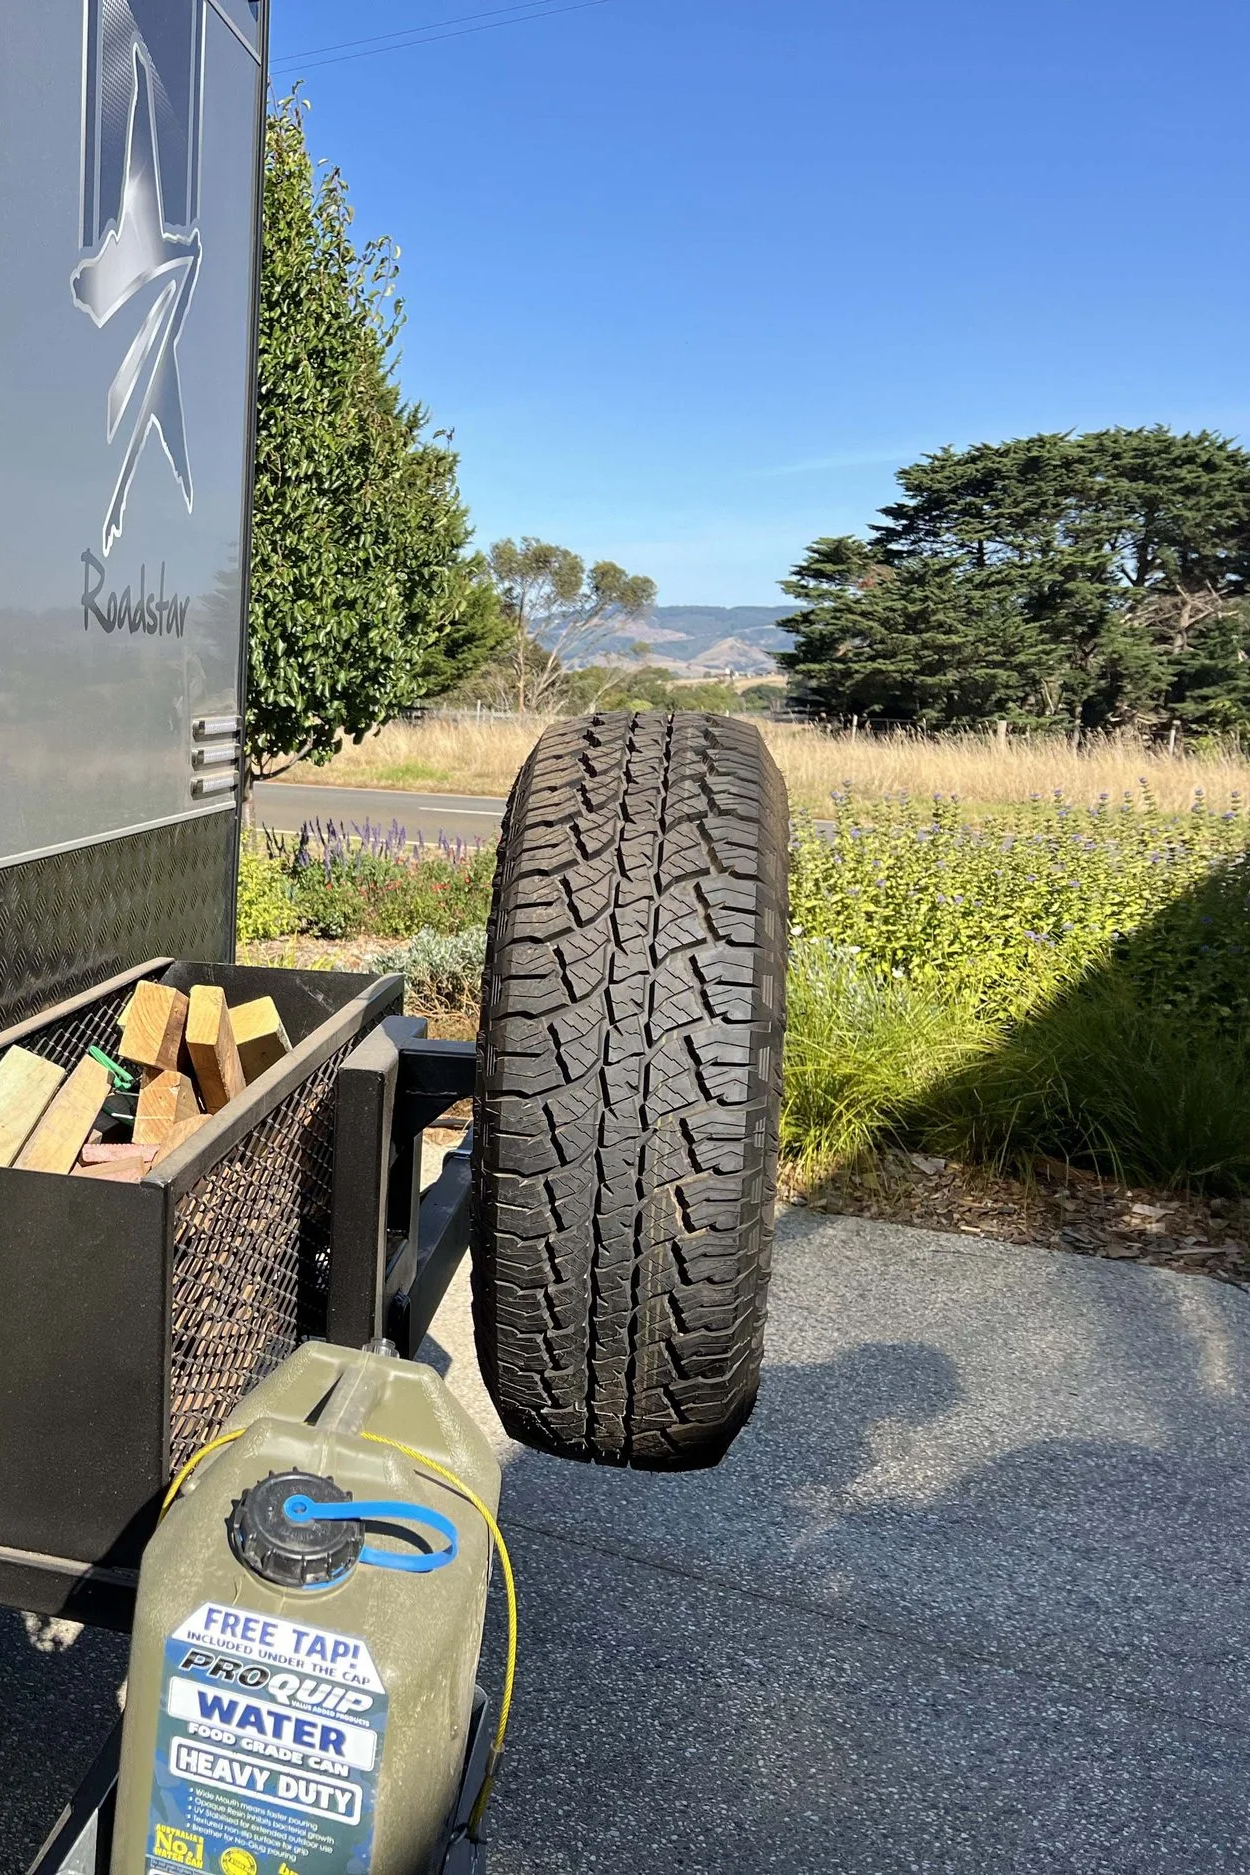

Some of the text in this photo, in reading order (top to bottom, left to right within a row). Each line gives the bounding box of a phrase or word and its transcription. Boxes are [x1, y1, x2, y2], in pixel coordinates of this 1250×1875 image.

[81, 548, 190, 638] Roadstar
[187, 1631, 371, 1686] INCLUDED UNDER THE CAP
[203, 1607, 361, 1669] FREE TAP!
[178, 1648, 374, 1715] PROQUIP
[197, 1690, 347, 1757] WATER
[291, 1699, 370, 1728] VALUE ADDED PRODUCTS
[188, 1722, 349, 1777] FOOD GRADE CAN
[178, 1747, 353, 1814] HEAVY DUTY
[193, 1815, 223, 1830] Textured
[193, 1806, 204, 1815] UV
[205, 1809, 239, 1826] Stabilised
[240, 1818, 250, 1829] for
[251, 1824, 287, 1840] extended
[288, 1835, 318, 1848] outdoor
[195, 1797, 226, 1813] Opaque
[227, 1805, 246, 1818] Resin
[273, 1821, 306, 1836] bacterial
[307, 1831, 335, 1845] growth
[196, 1788, 318, 1832] Wide Mouth means faster pouring
[192, 1824, 222, 1839] Breather
[267, 1847, 297, 1862] pouring
